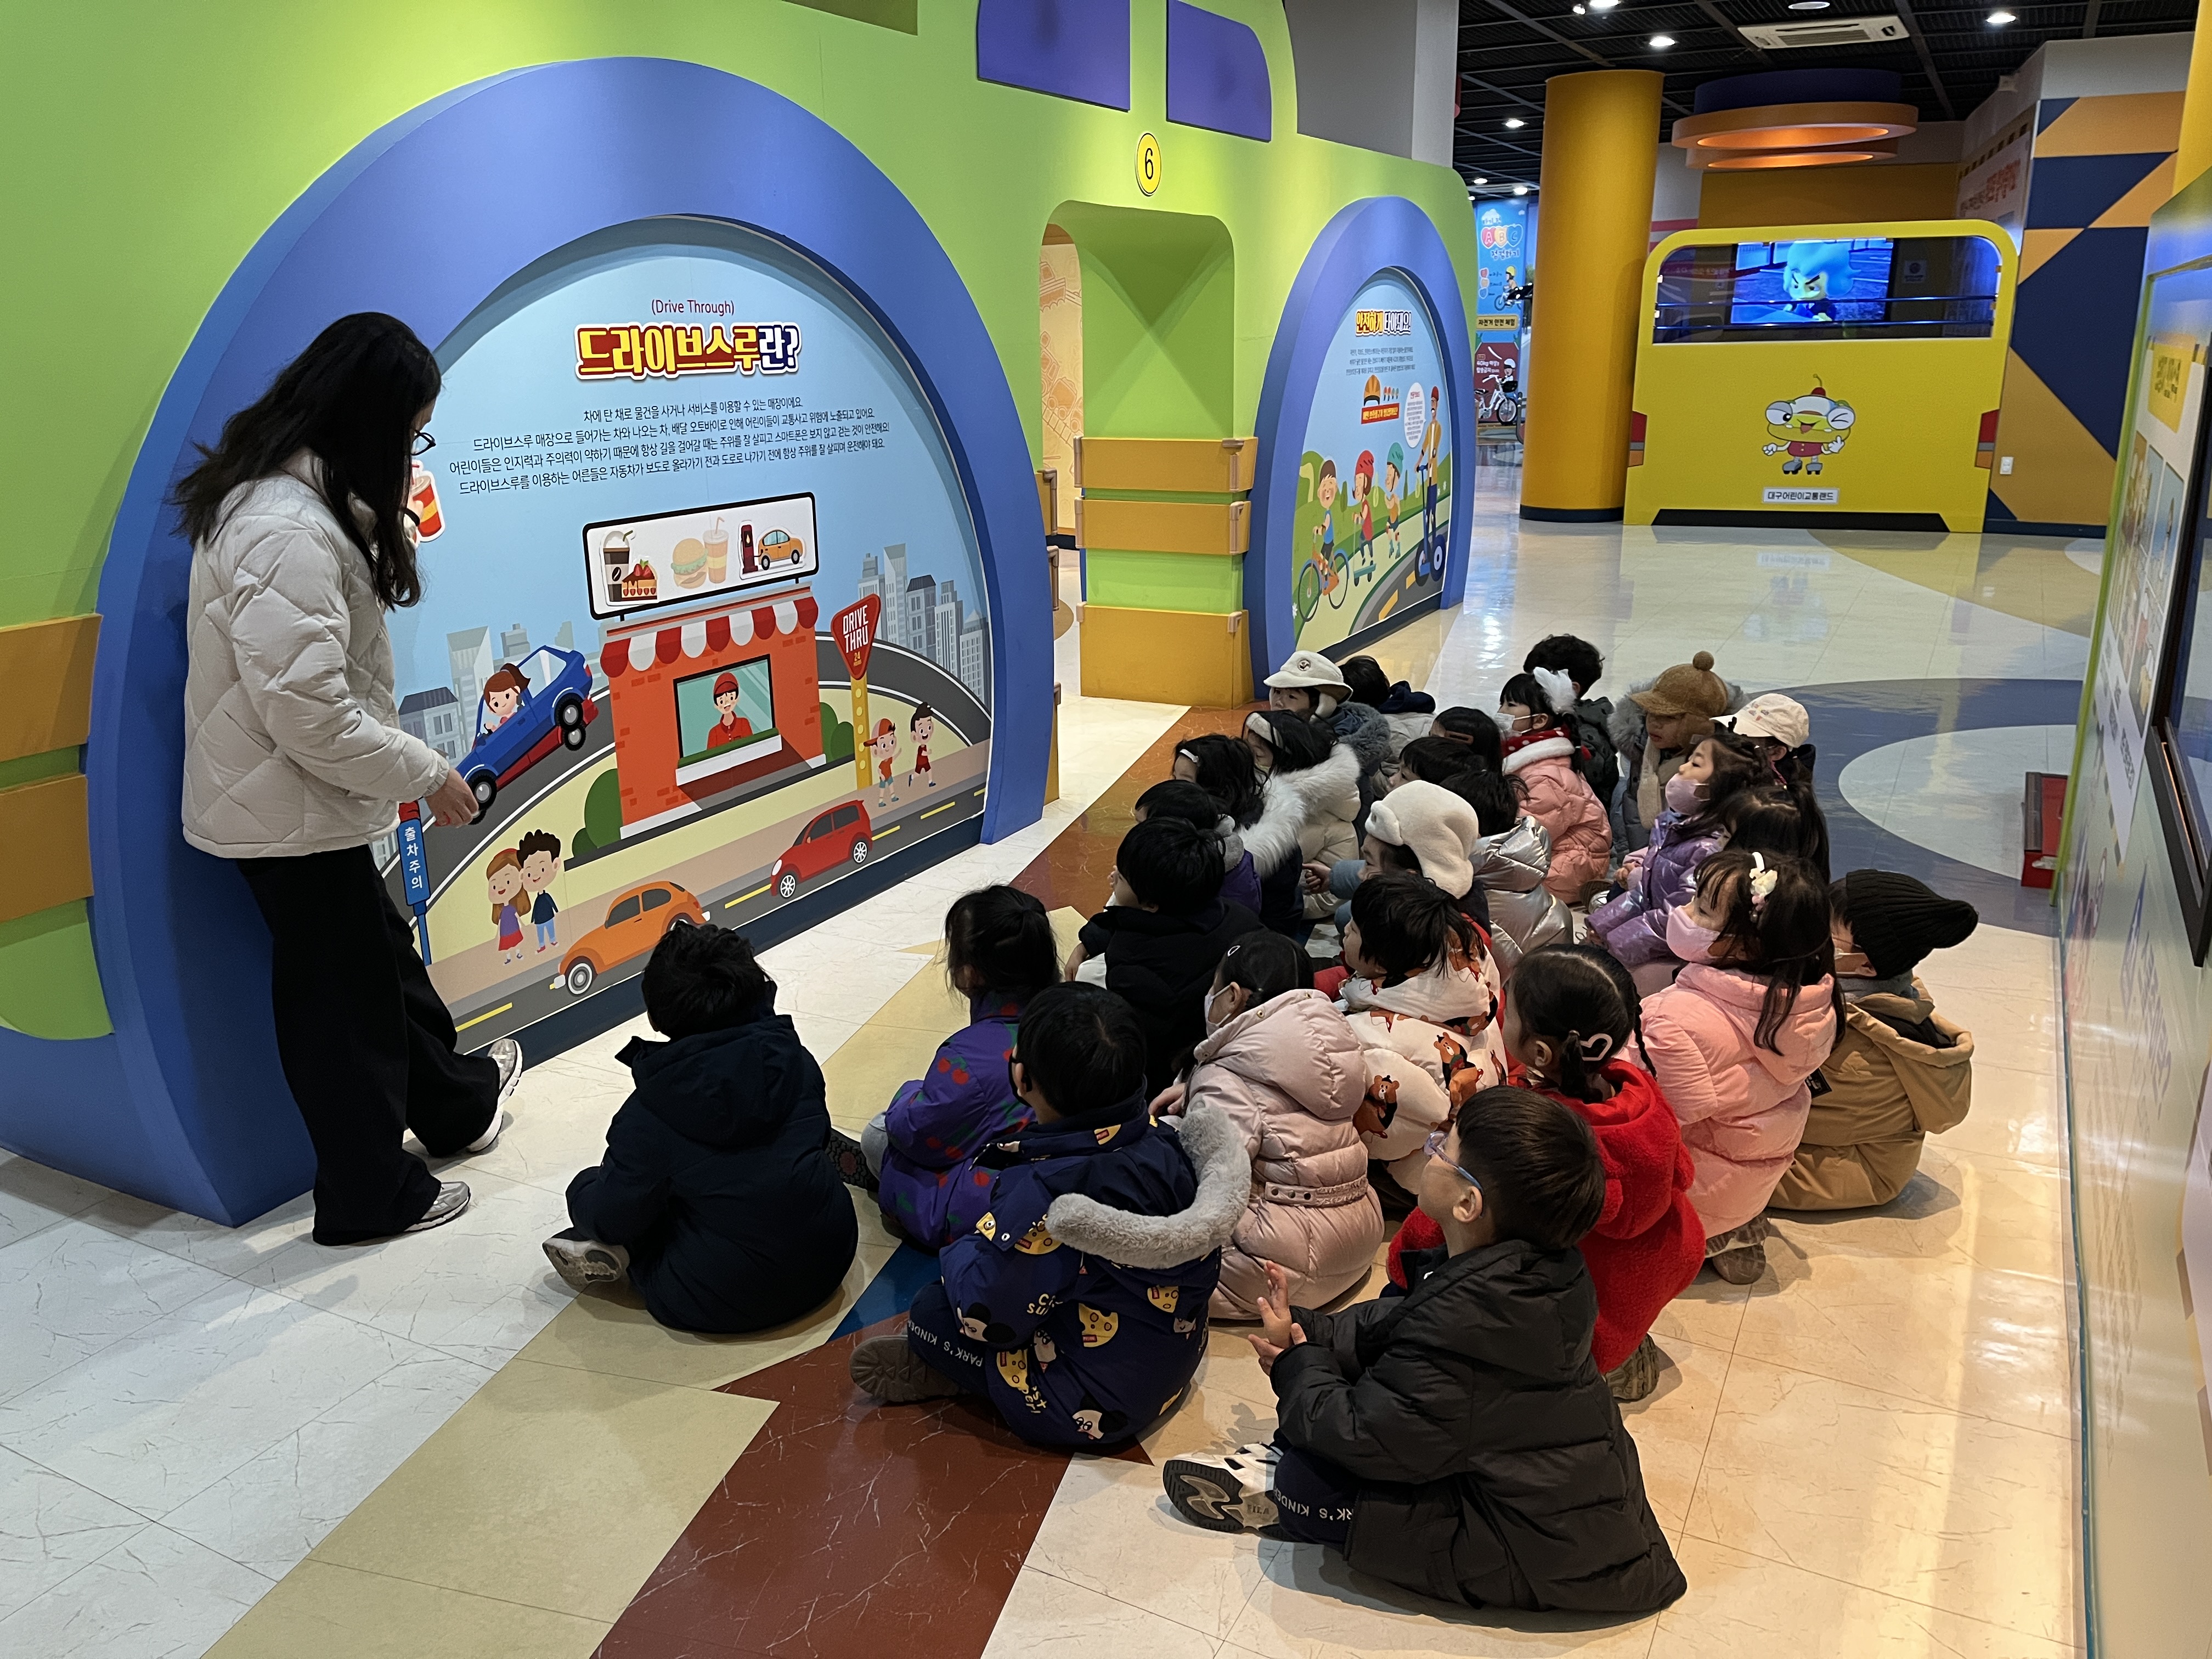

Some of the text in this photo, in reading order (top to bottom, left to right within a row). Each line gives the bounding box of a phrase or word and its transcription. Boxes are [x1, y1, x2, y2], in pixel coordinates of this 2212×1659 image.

[1145, 148, 1154, 180] 6
[651, 299, 735, 317] (Drive Through)
[1356, 311, 1383, 334] 안전하게
[578, 325, 801, 375] 드라이브스루란?
[584, 397, 803, 423] 차에 탄 채로 물건을 사거나 서비스를 이용할 수 있는 매장이에요
[473, 408, 874, 452] 드라이브스루 매장으로 들어가는 차와 나오는 차, 배달 오토바이로 인해 어린이들이 교통사고 위험에 노출되고 있어요
[450, 422, 889, 475] 어린이들은 인지력과 주의력이 약하기 때문에 항상 길을 걸어갈 때는 주위를 잘 살피고 스마트폰은 보지 않고 걷는 것이 안전해요!
[460, 438, 885, 494] 드라이브스루를 이용하는 어른들은 자동차가 보도로 올라가기 전과 도로로 나가기 전에 항상 주위를 잘 살피며 운전해야 돼요
[843, 605, 868, 635] DRIVE
[844, 625, 868, 653] THRU
[854, 651, 861, 662] 24
[943, 1341, 983, 1367] PARK'S
[1319, 1508, 1354, 1521] RK'S
